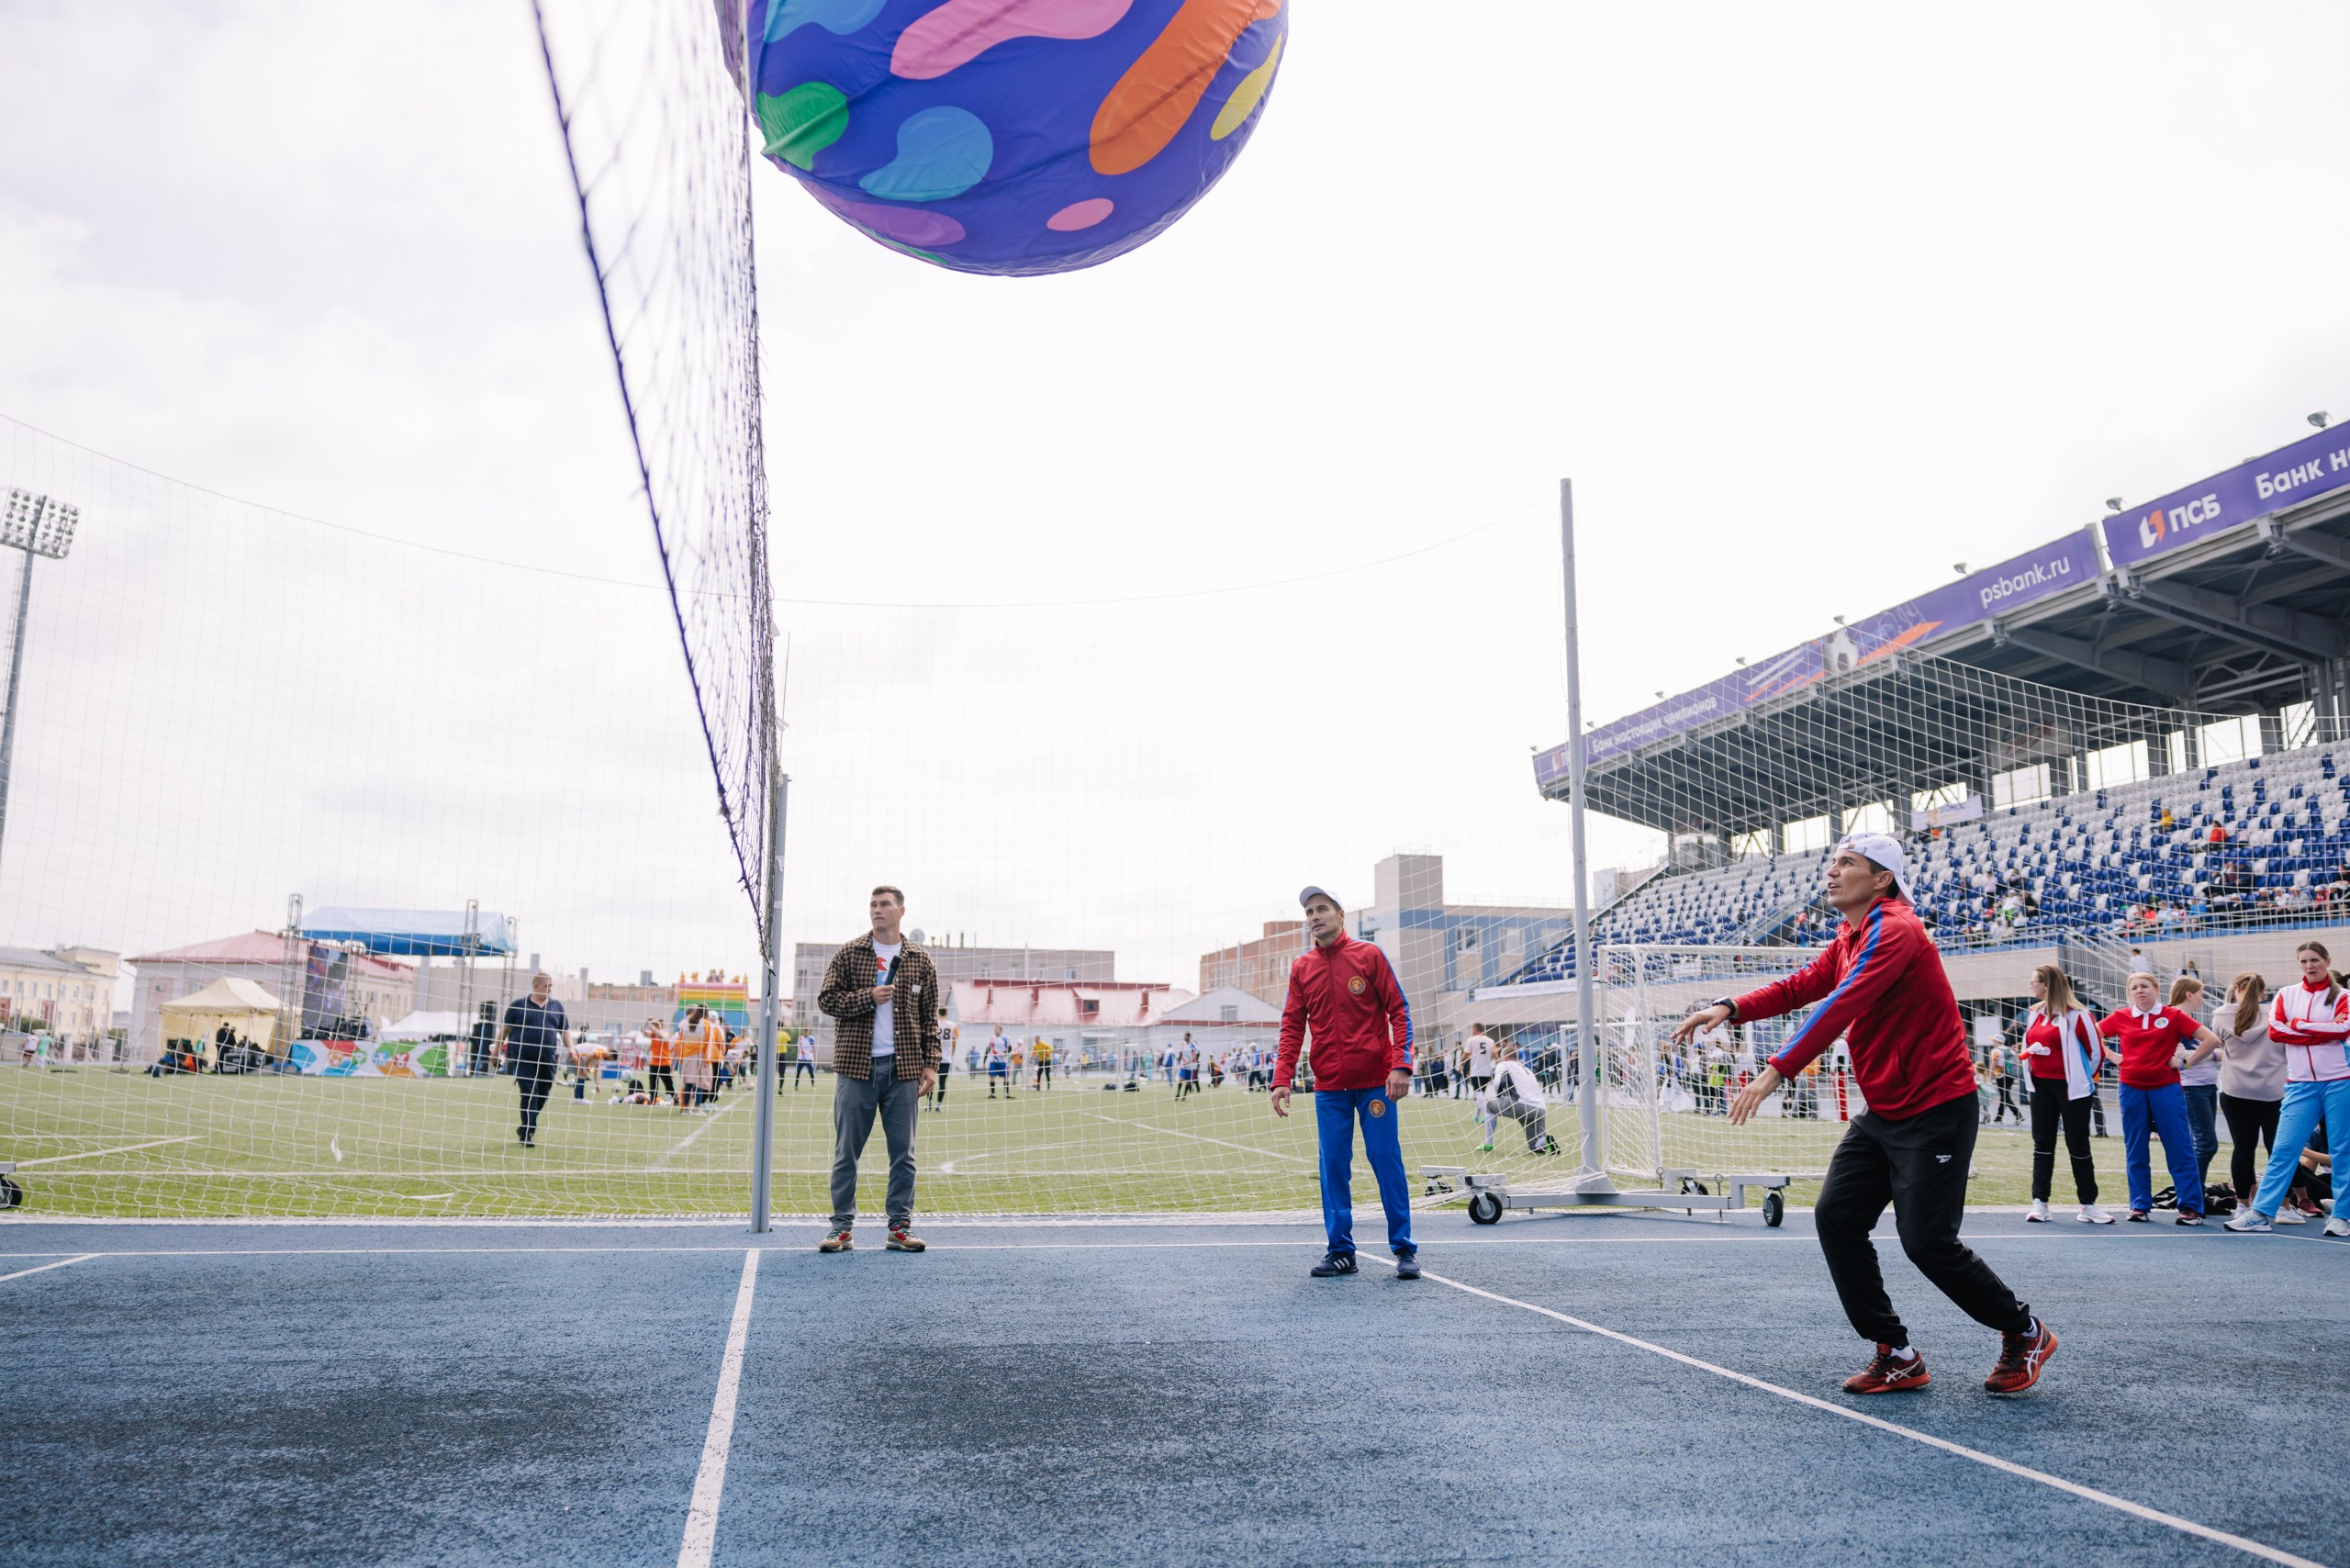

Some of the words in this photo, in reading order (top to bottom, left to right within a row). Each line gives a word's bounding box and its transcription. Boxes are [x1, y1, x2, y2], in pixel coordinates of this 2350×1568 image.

[2255, 458, 2325, 499] Банк
[2329, 445, 2350, 472] н
[2168, 493, 2221, 532] ПСБ
[1980, 556, 2070, 609] psbank.ru
[1592, 737, 1614, 753] Банк
[1663, 697, 1718, 725] чемпионов
[1479, 1042, 1486, 1055] 5
